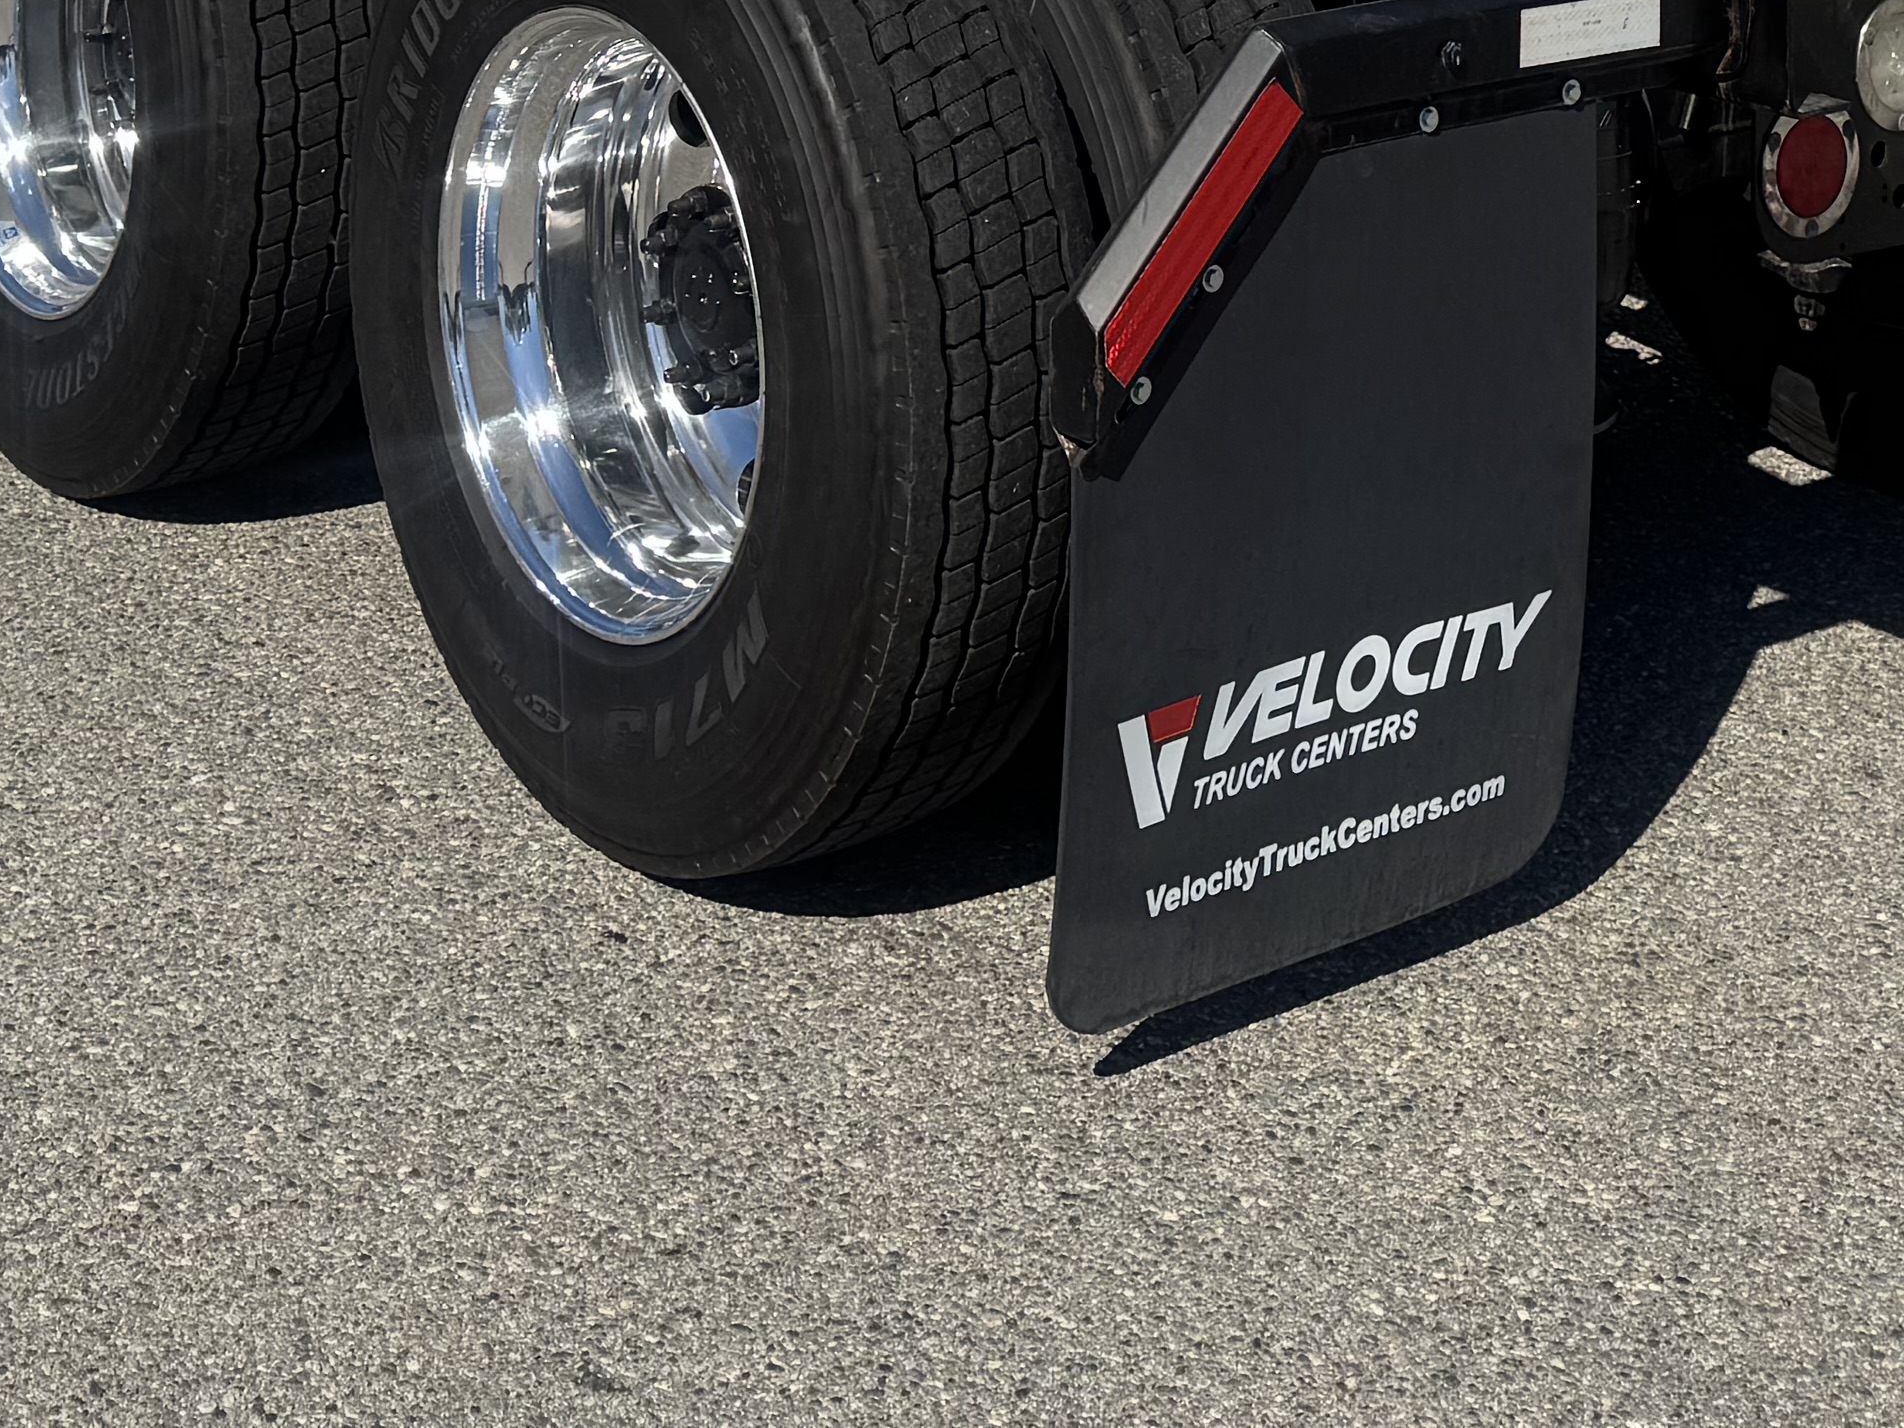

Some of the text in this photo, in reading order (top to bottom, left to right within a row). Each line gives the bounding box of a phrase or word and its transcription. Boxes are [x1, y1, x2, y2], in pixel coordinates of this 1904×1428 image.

[1203, 590, 1552, 761] VELOCITY
[1192, 708, 1420, 811] TRUCK CENTERS
[1144, 774, 1506, 919] VelocityTruckCenters.com
